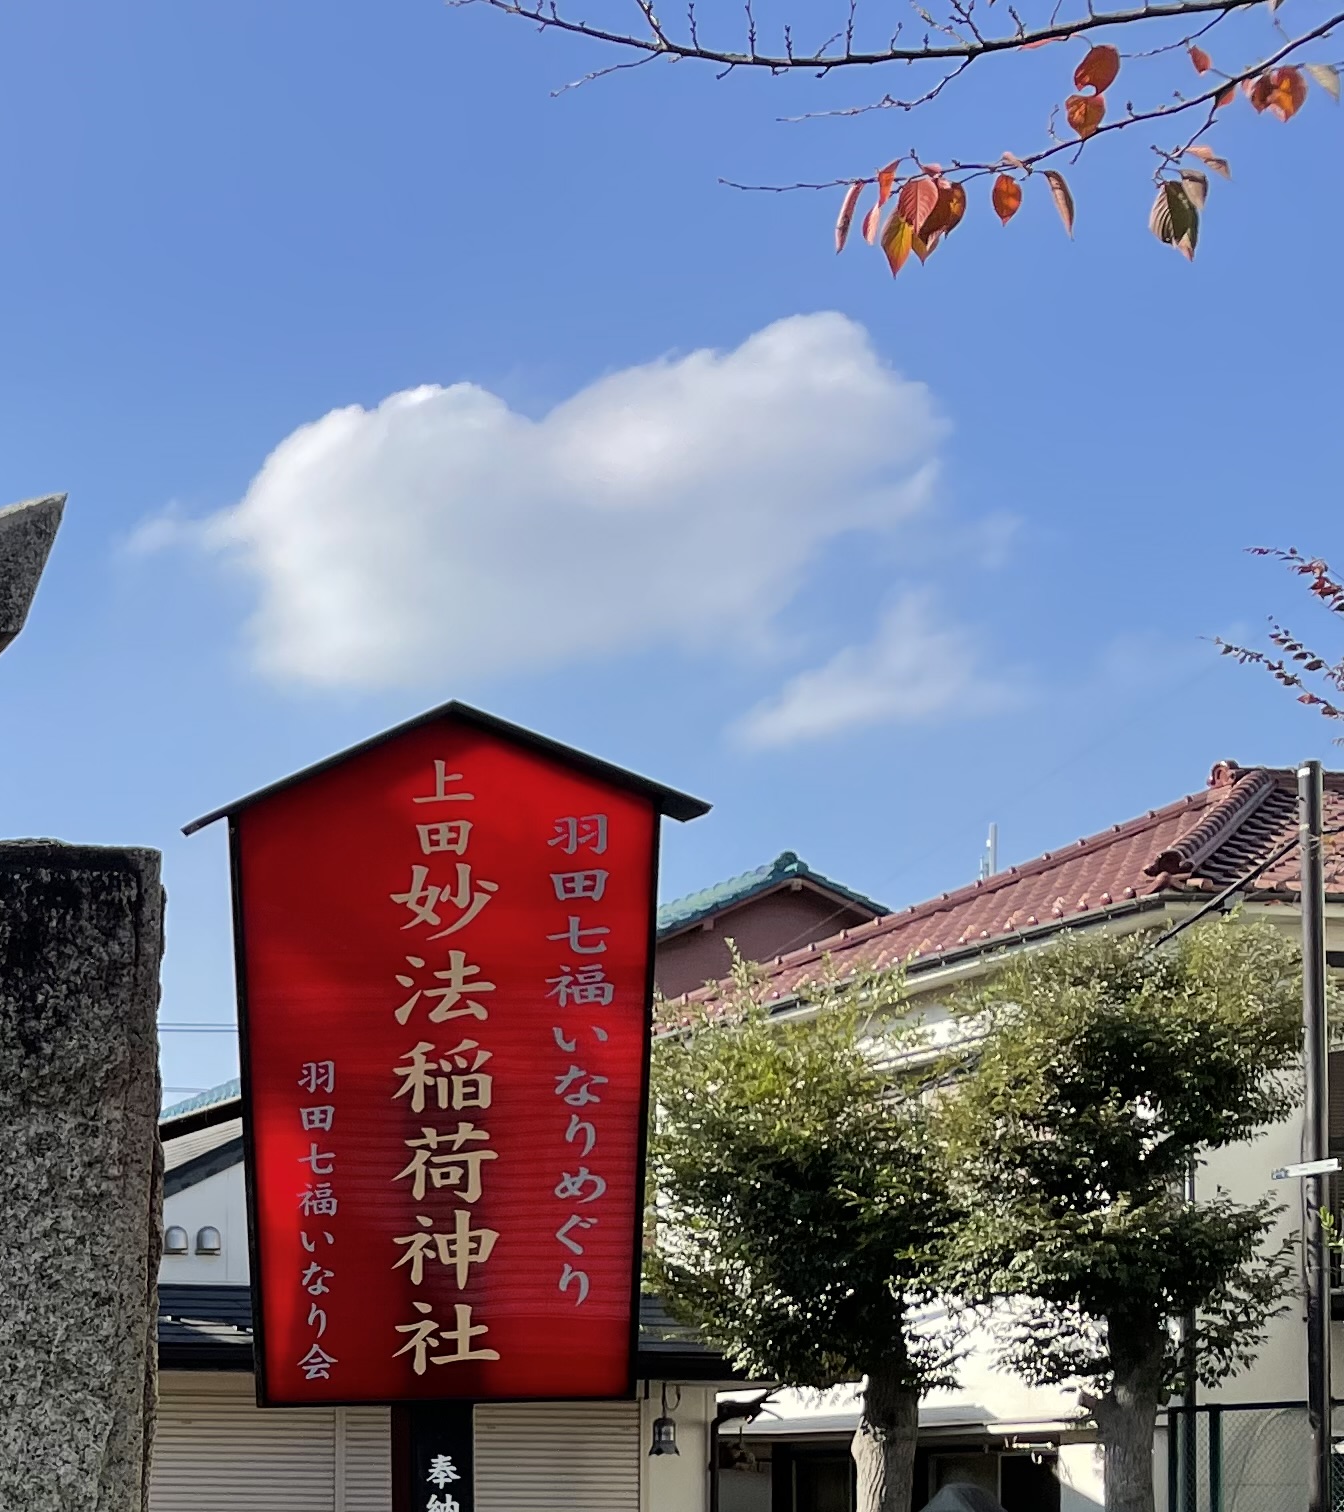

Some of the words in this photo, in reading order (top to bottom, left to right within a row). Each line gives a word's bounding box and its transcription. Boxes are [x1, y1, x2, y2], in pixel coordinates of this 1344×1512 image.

[296, 1060, 339, 1380] 羽田七福いなり会
[390, 760, 500, 1376] 上田妙法稲荷神社
[544, 813, 614, 1307] 羽田七福いなりめぐり
